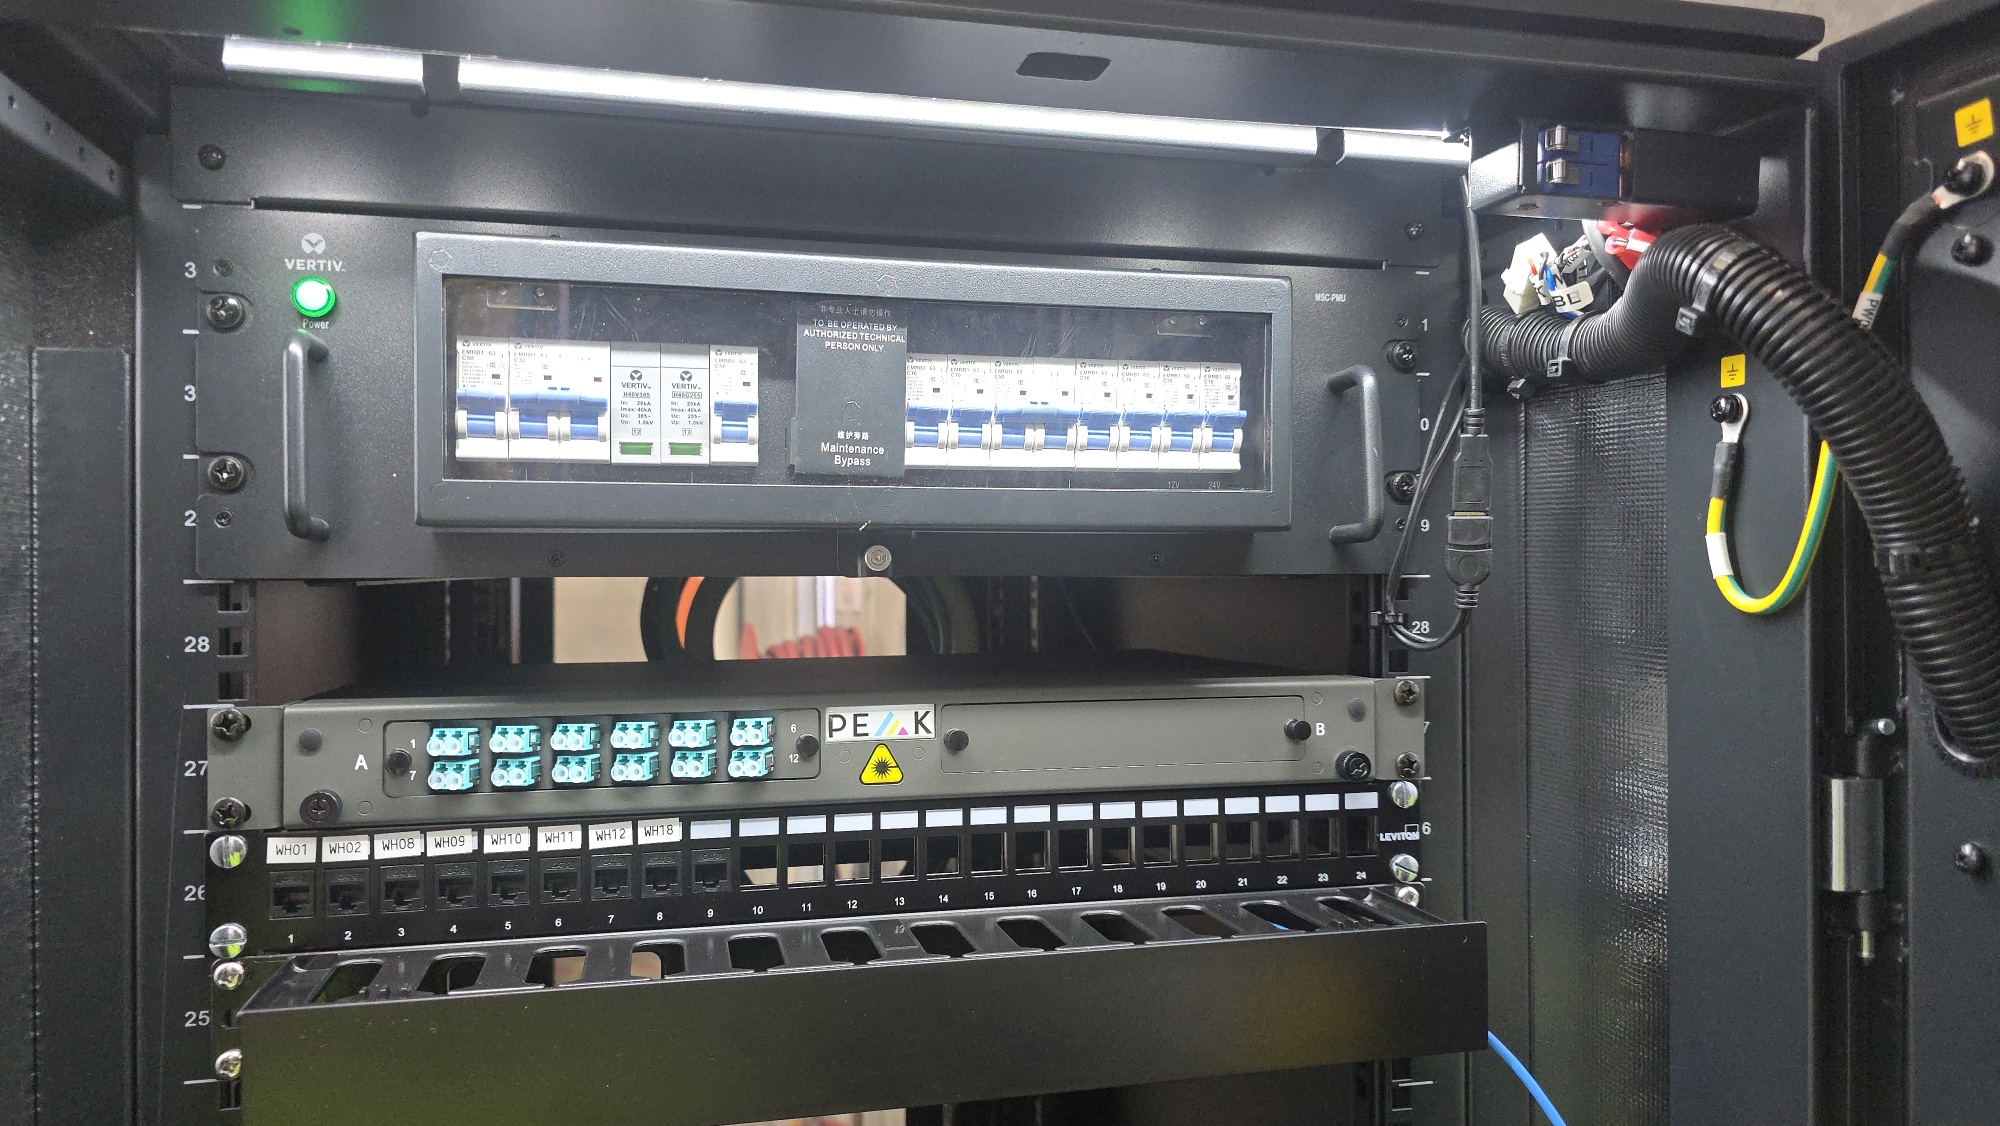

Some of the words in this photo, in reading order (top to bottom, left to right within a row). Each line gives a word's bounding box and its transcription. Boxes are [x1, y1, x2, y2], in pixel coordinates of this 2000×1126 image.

[284, 258, 344, 272] VERTIV
[1315, 293, 1347, 302] MSC-PMU
[1552, 290, 1582, 307] BL
[302, 319, 330, 330] Power
[812, 318, 824, 327] TO
[827, 320, 839, 328] BE
[840, 320, 885, 331] OPERATED
[886, 323, 898, 332] BY
[803, 329, 858, 340] AUTHORIZED
[860, 332, 906, 343] TECHNICAL
[825, 341, 861, 351] PERSON
[862, 343, 885, 352] ONLY
[671, 382, 698, 390] VERTIV
[821, 442, 885, 455] Maintenance
[834, 454, 871, 467] Bypass
[1168, 480, 1181, 489] 12V
[1208, 481, 1221, 489] 24V
[1411, 621, 1430, 634] 28
[184, 636, 210, 653] 28
[790, 724, 797, 733] 6
[828, 709, 932, 738] PEAK
[1315, 722, 1326, 736] B
[410, 738, 416, 748] 1
[354, 754, 368, 770] A
[788, 754, 799, 763] 12
[184, 760, 209, 777] 27
[409, 770, 416, 780] 7
[275, 843, 307, 856] WH01
[328, 841, 362, 854] WH02
[381, 837, 415, 851] WH08
[434, 835, 465, 849] WH09
[490, 833, 522, 846] WH10
[544, 831, 574, 844] WH11
[595, 828, 626, 842] WH12
[643, 824, 674, 837] WH18
[1379, 831, 1420, 841] LEVITON
[184, 884, 206, 901] 26
[287, 934, 294, 944] 1
[344, 930, 352, 941] 2
[397, 927, 405, 937] 3
[450, 924, 457, 934] 4
[504, 921, 512, 930] 5
[555, 918, 562, 927] 6
[608, 914, 615, 924] 7
[656, 911, 663, 921] 8
[707, 908, 714, 918] 9
[752, 905, 764, 915] 10
[801, 902, 812, 912] 11
[847, 899, 858, 909] 12
[894, 896, 905, 906] 13
[938, 894, 949, 903] 14
[984, 891, 995, 900] 15
[1026, 888, 1037, 898] 16
[1072, 886, 1082, 896] 17
[1112, 884, 1123, 893] 18
[1156, 881, 1167, 891] 19
[1195, 880, 1207, 889] 20
[1238, 877, 1248, 887] 21
[1277, 875, 1288, 885] 22
[1317, 873, 1329, 882] 23
[1356, 871, 1367, 880] 24
[184, 1010, 210, 1027] 25
